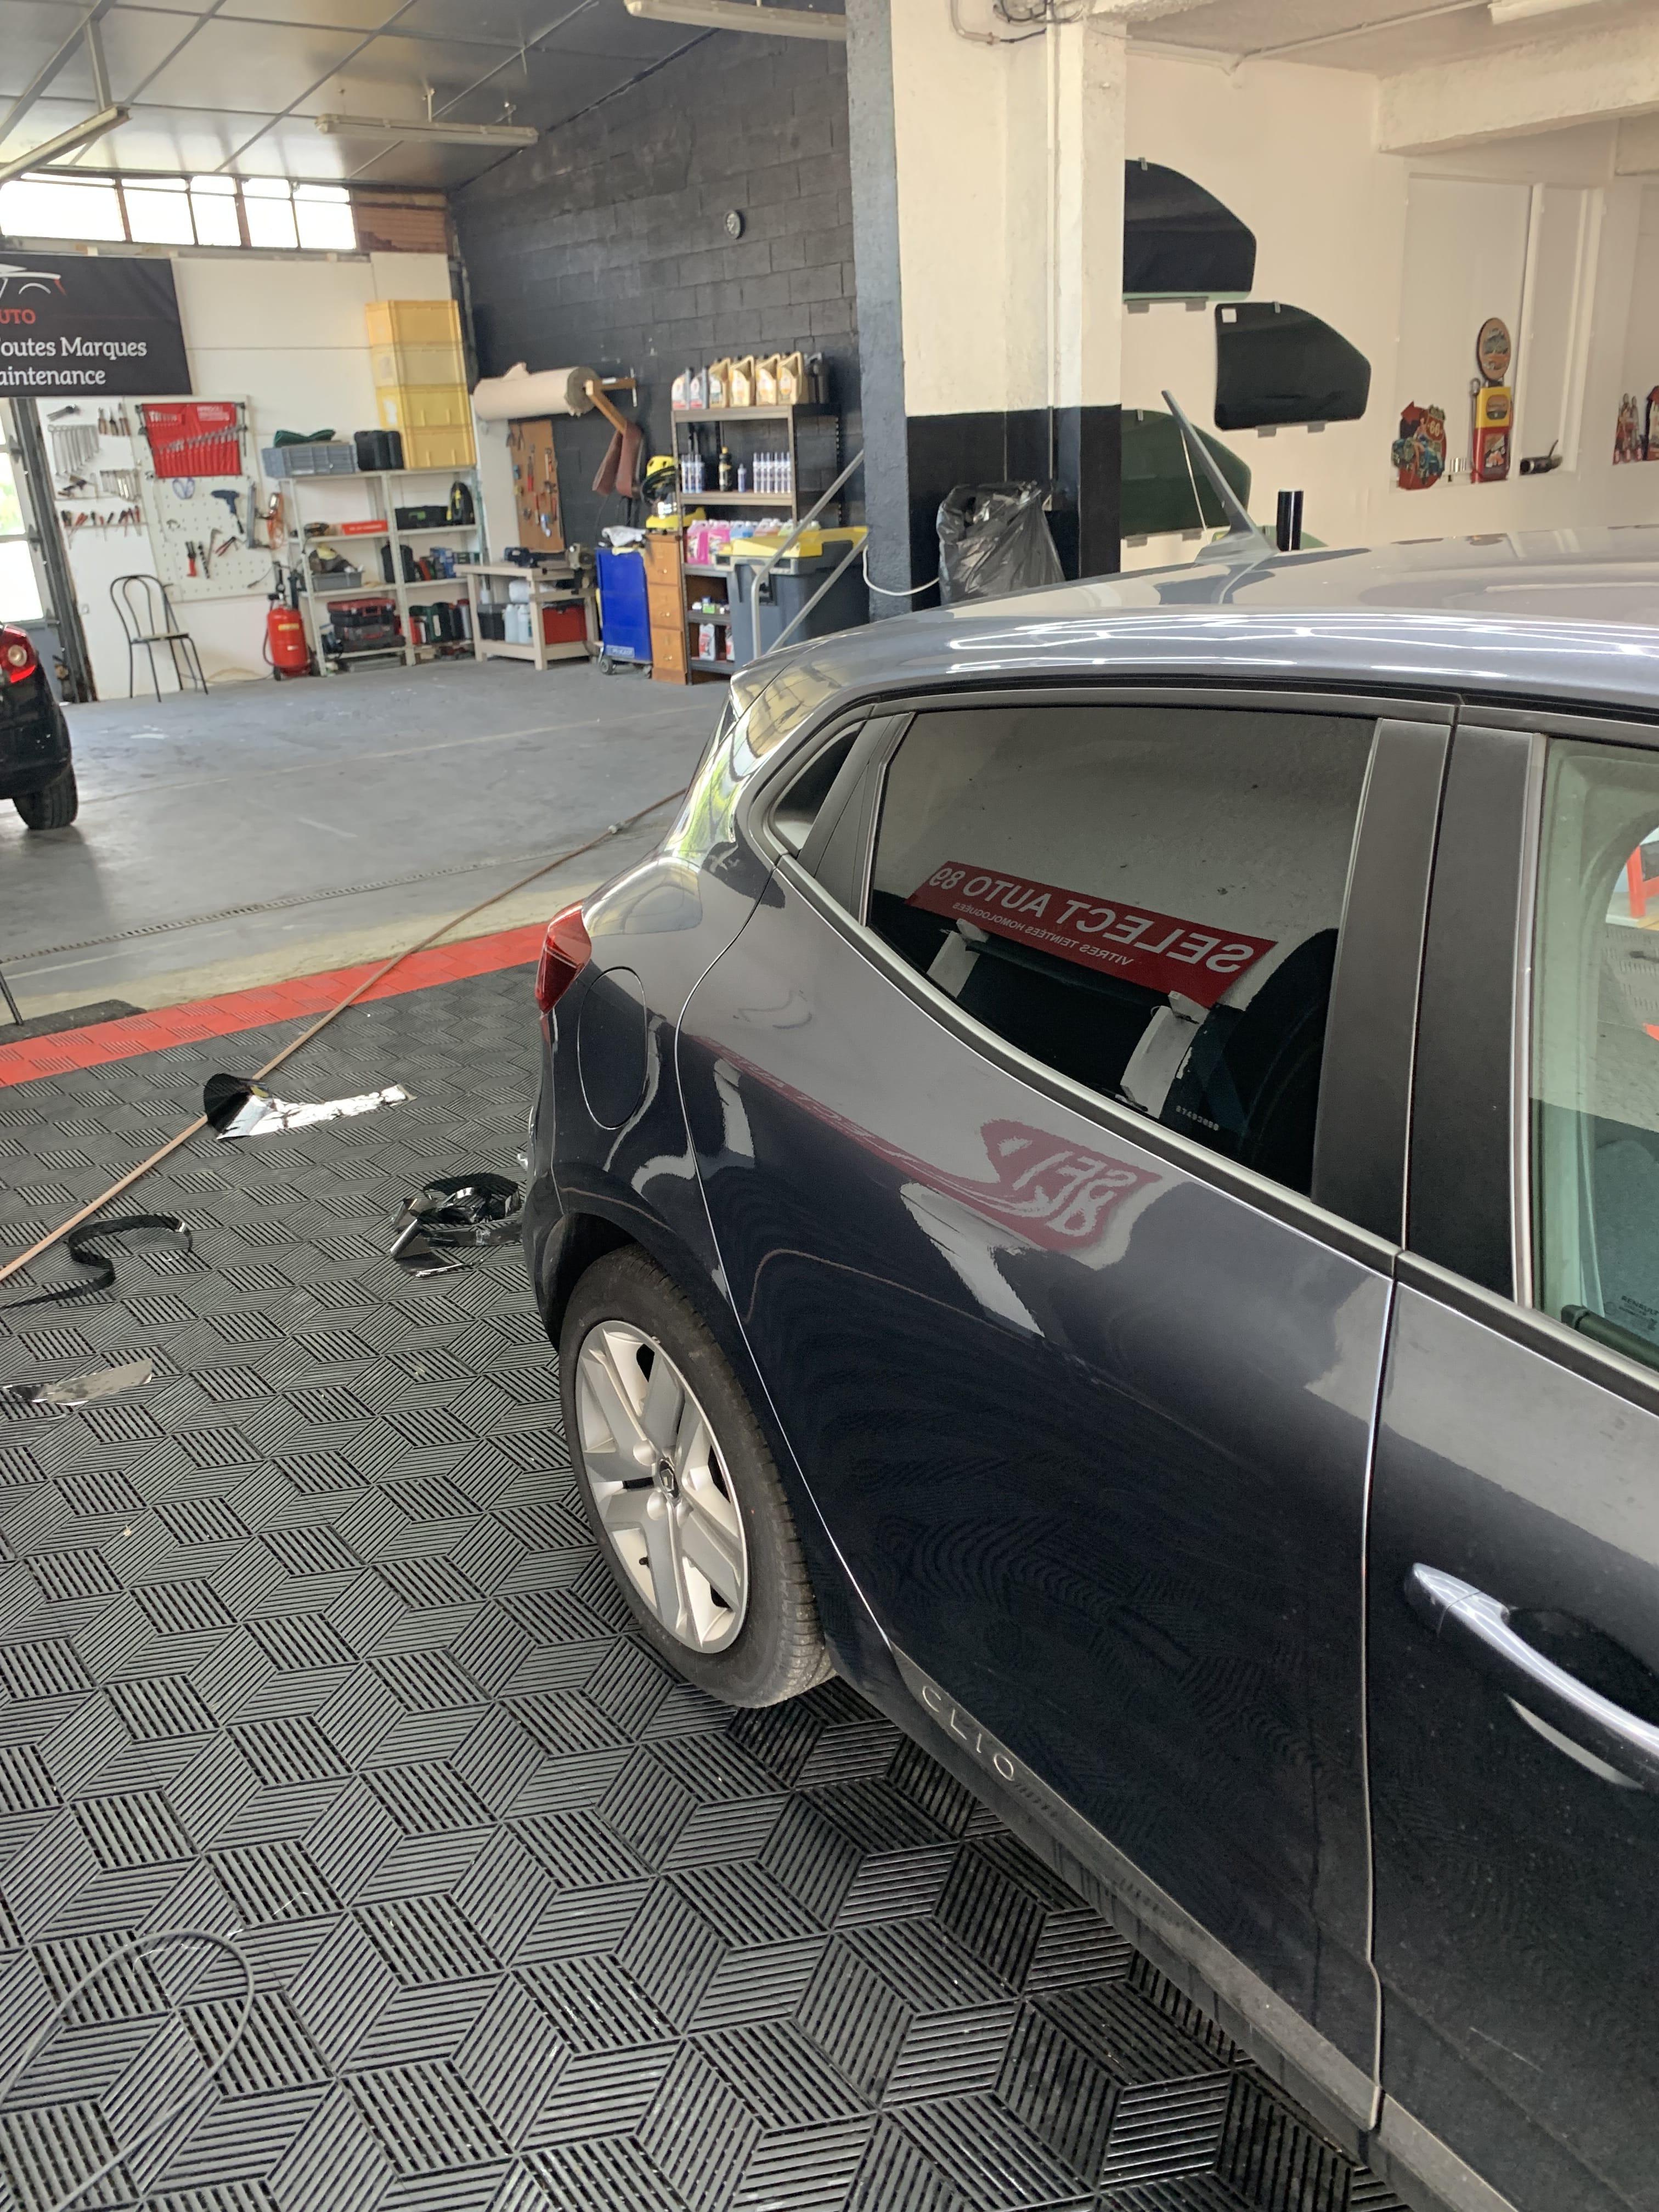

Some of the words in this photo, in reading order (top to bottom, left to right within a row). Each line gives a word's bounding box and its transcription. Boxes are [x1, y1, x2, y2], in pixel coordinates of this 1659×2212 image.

[0, 336, 57, 357] outes
[60, 336, 148, 360] Marques
[1429, 420, 1441, 437] 66
[922, 1685, 1015, 1781] CLIO
